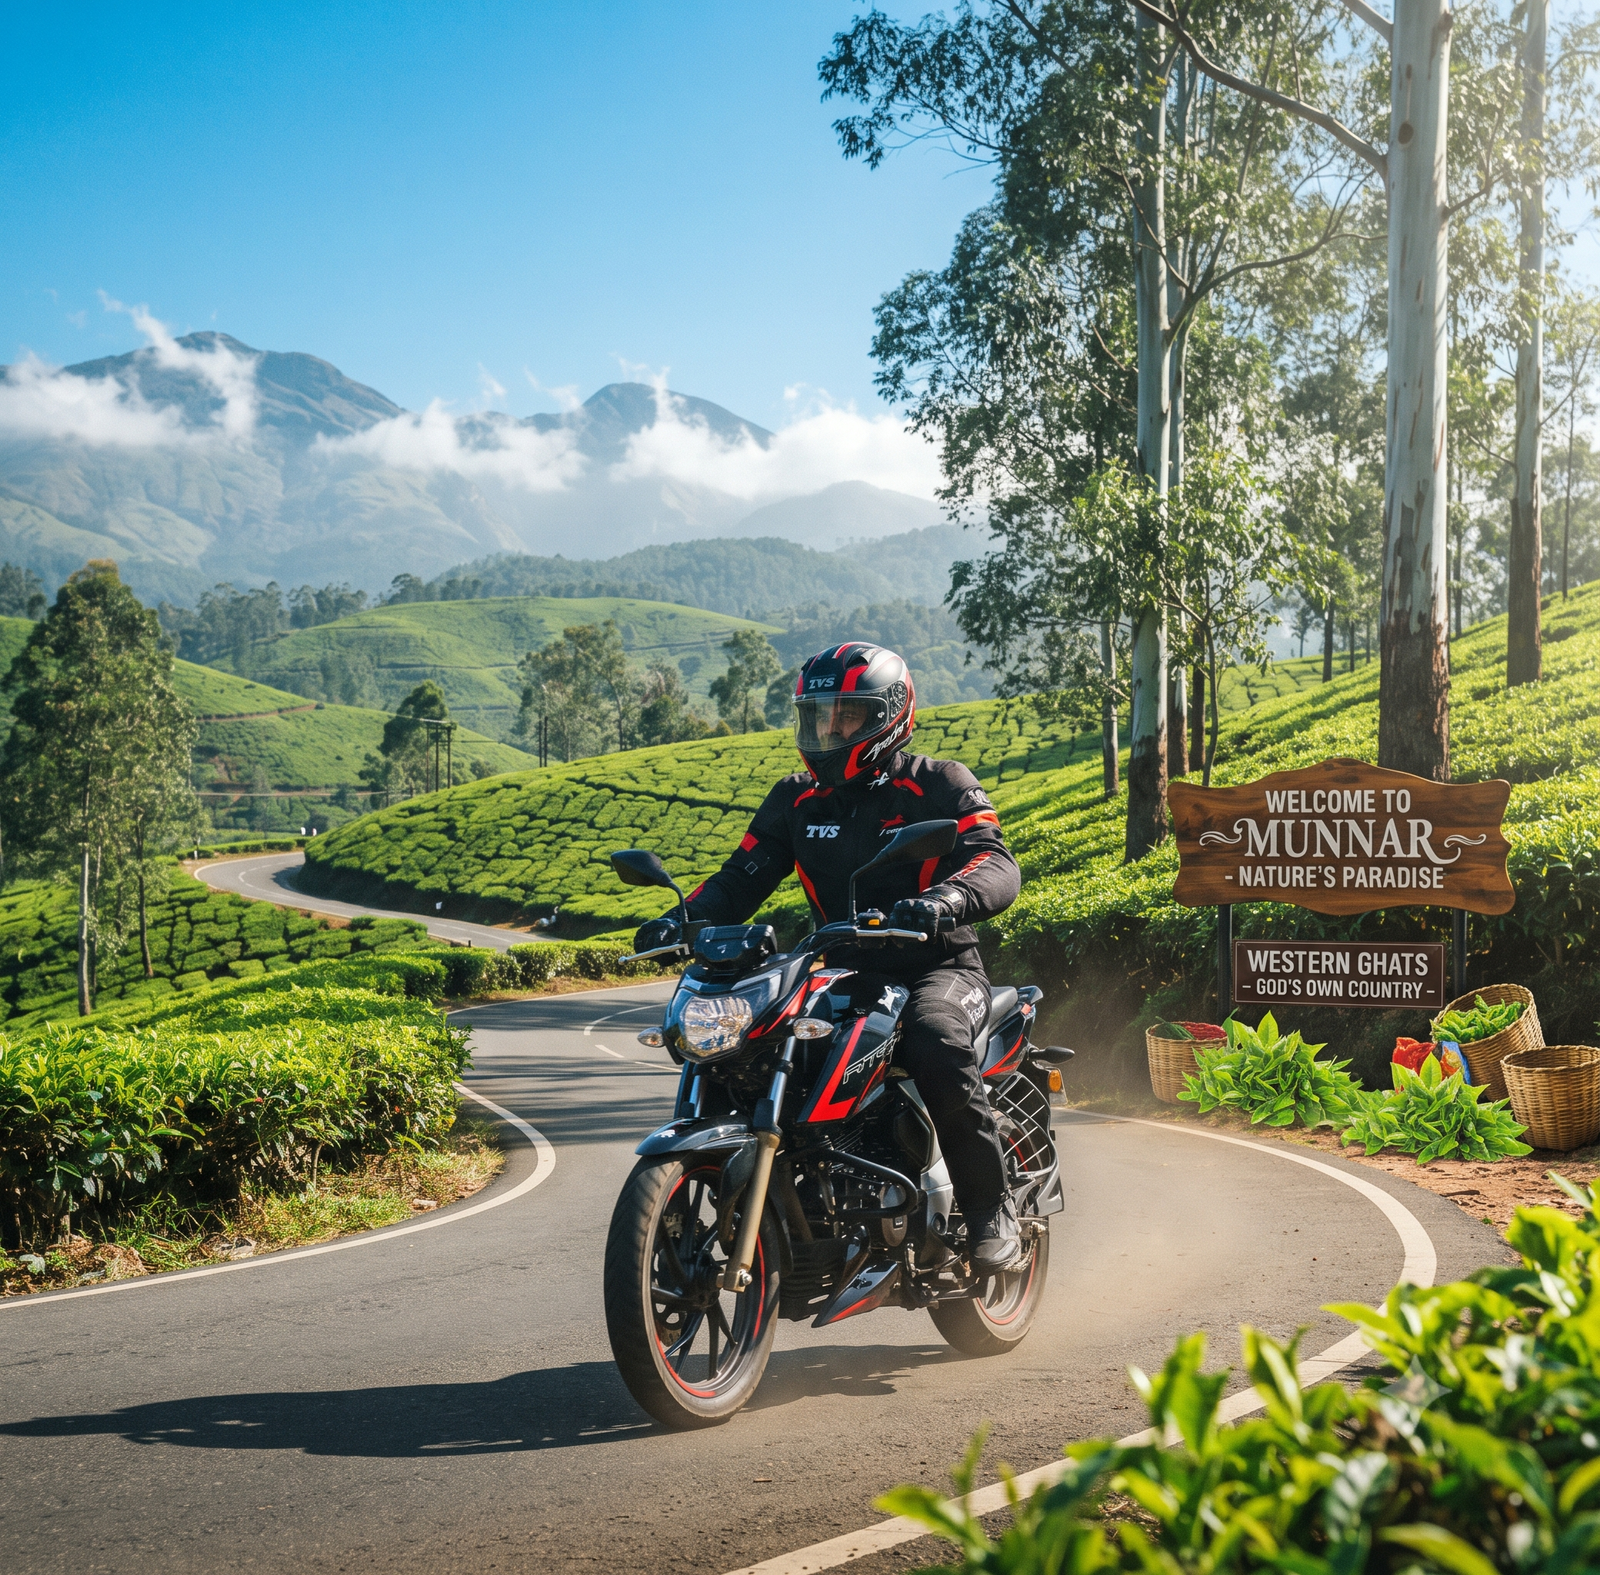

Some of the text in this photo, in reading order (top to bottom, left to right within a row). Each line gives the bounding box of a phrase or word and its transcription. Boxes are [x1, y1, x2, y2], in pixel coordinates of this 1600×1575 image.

[809, 677, 835, 689] TVS
[1265, 789, 1411, 813] WELCOME TO
[806, 825, 840, 838] TVS
[1233, 818, 1461, 865] MUNNAR
[1239, 865, 1336, 888] NATURE’S
[1343, 866, 1444, 889] PARADISE
[1247, 950, 1428, 976] WESTERN GHATS
[1256, 978, 1302, 996] GOD'S
[1306, 979, 1343, 997] OWN
[1348, 980, 1423, 999] COUNTRY
